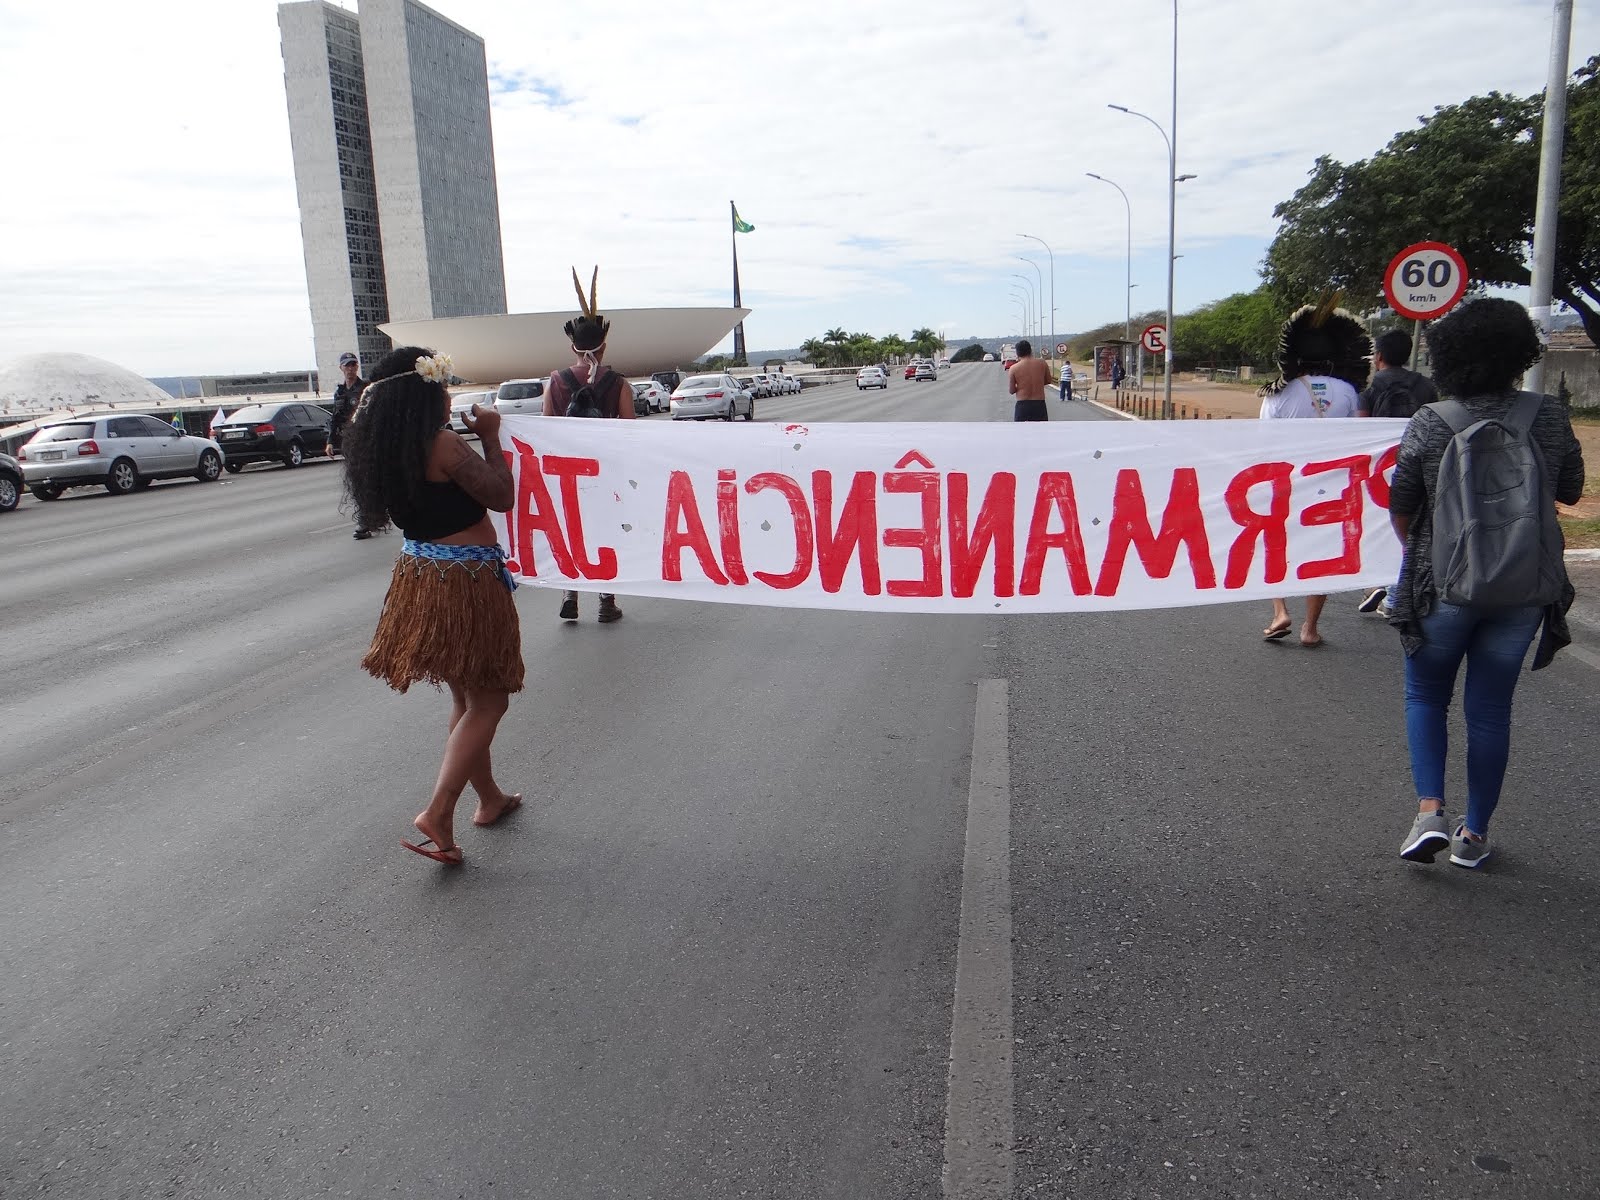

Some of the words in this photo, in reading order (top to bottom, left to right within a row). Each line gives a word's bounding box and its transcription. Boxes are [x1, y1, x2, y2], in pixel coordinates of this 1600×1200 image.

[1402, 260, 1451, 287] 60
[1409, 293, 1437, 303] km/h
[1150, 331, 1161, 347] E
